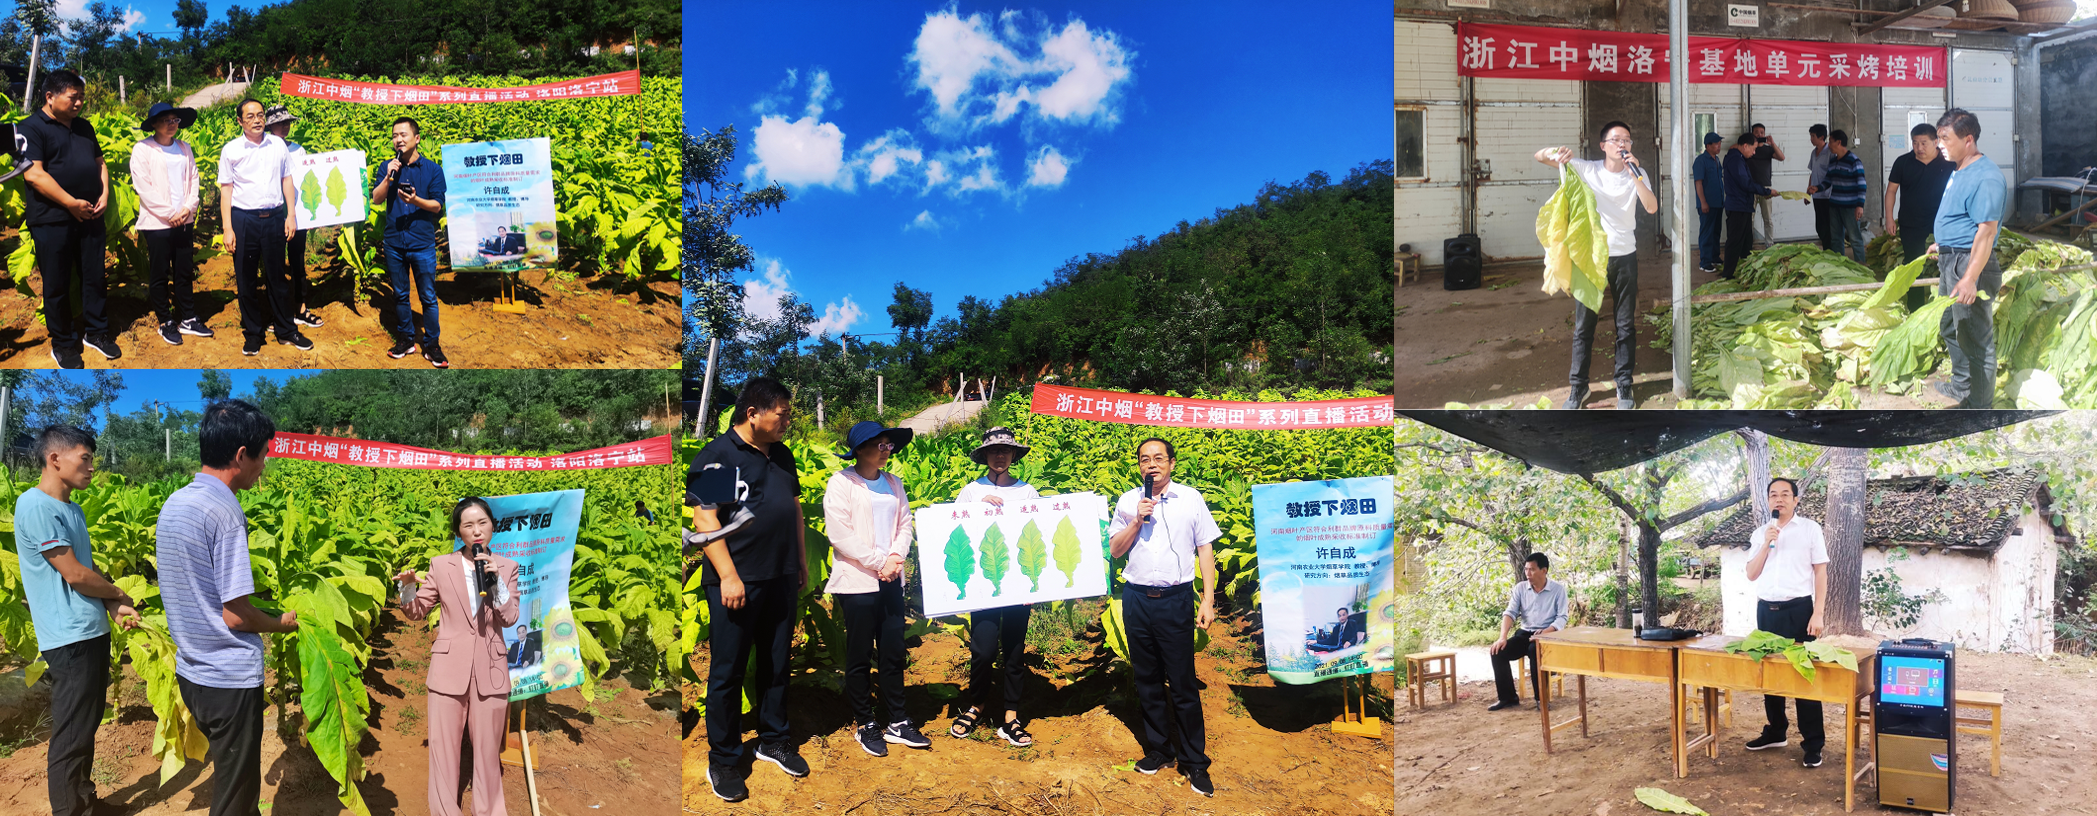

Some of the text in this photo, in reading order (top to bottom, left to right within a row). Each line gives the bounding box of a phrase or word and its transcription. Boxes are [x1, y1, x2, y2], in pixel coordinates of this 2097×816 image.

[1462, 36, 1934, 81] 浙江中烟洛基地单元采烤培训
[537, 79, 619, 97] 洛阳洛宁站
[464, 153, 524, 168] 教授下烟田
[484, 186, 510, 195] 许自成
[1056, 393, 1394, 426] 浙江中烟“教授下烟田”系列直播活动
[551, 446, 646, 469] 洛阳洛宁站
[1285, 498, 1377, 518] 教授下烟田
[1316, 546, 1357, 560] 许自成
